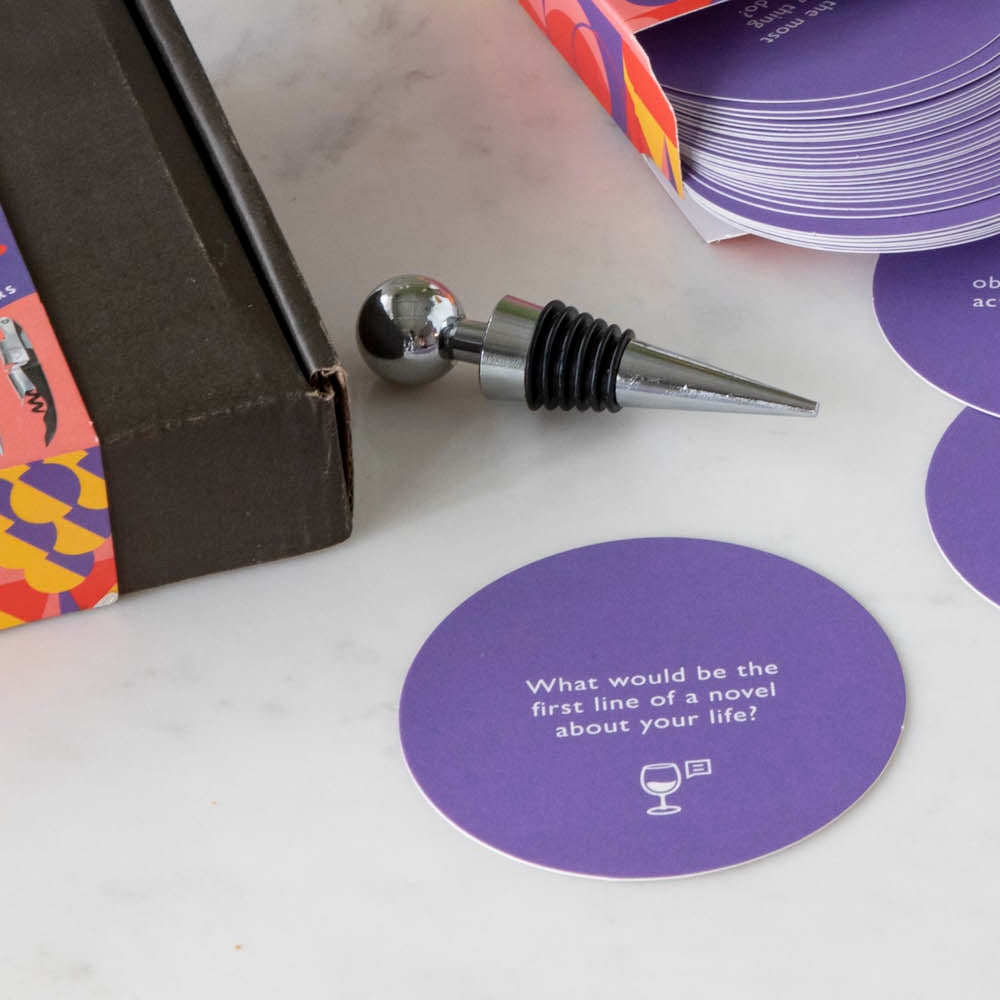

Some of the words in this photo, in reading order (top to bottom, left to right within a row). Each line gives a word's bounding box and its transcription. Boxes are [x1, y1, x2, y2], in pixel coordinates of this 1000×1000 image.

[746, 3, 796, 30] thing
[805, 0, 837, 18] the
[760, 17, 805, 44] most
[525, 677, 599, 695] What
[608, 666, 687, 688] would
[697, 664, 727, 681] be
[736, 661, 780, 678] the
[531, 699, 585, 718] first
[593, 696, 640, 713] line
[650, 689, 677, 707] of
[685, 691, 700, 705] a
[708, 681, 777, 703] novel
[555, 719, 631, 739] about
[639, 713, 700, 736] your
[708, 704, 758, 725] life?
